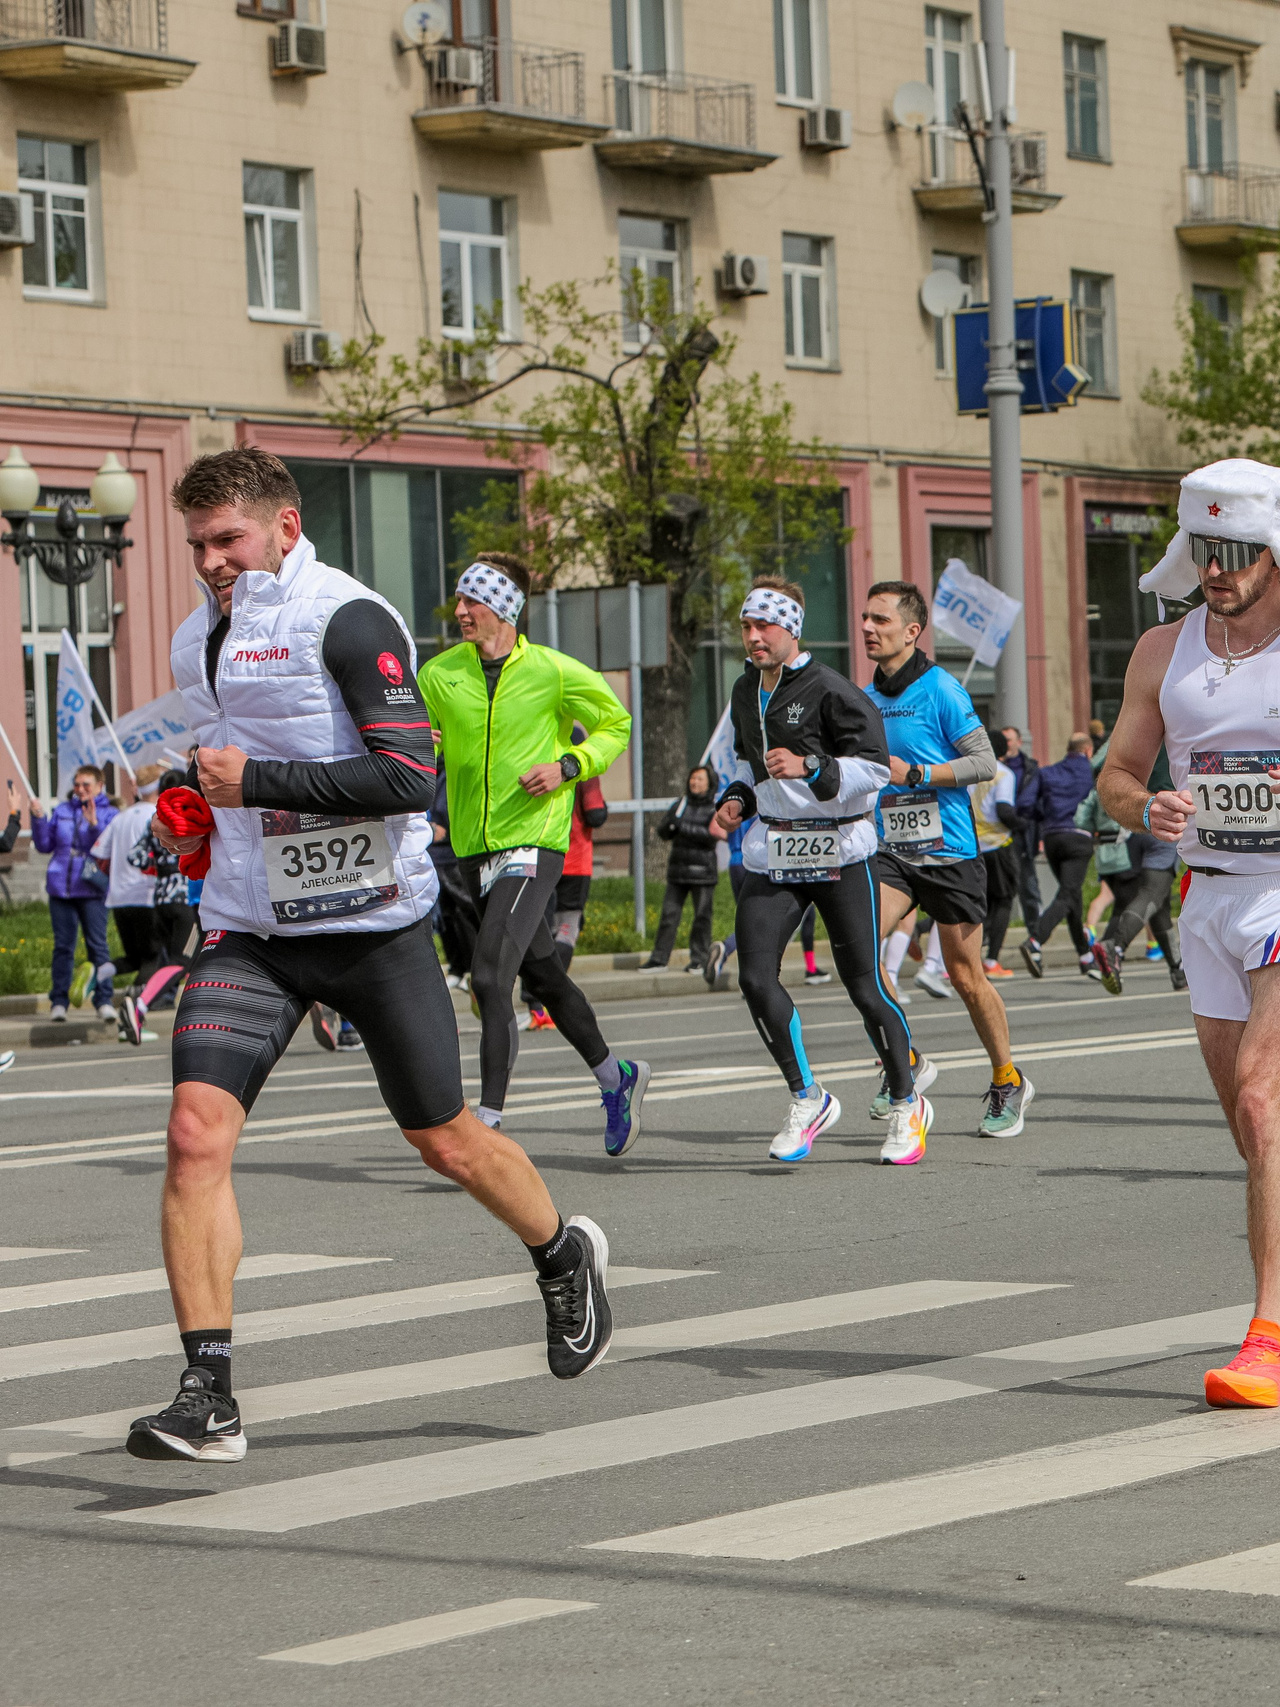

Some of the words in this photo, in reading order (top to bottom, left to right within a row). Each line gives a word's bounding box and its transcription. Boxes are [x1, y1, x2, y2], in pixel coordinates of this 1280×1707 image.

[233, 646, 289, 663] ЛУКОЙЛ
[384, 687, 413, 696] СОВЕТ
[301, 821, 331, 830] МАРАФОН
[889, 810, 931, 831] 5983
[1223, 815, 1268, 825] ДМИТРИЙ
[774, 837, 835, 857] 12262
[281, 834, 376, 878] 3592
[301, 872, 363, 890] АЛЕКСАНДР
